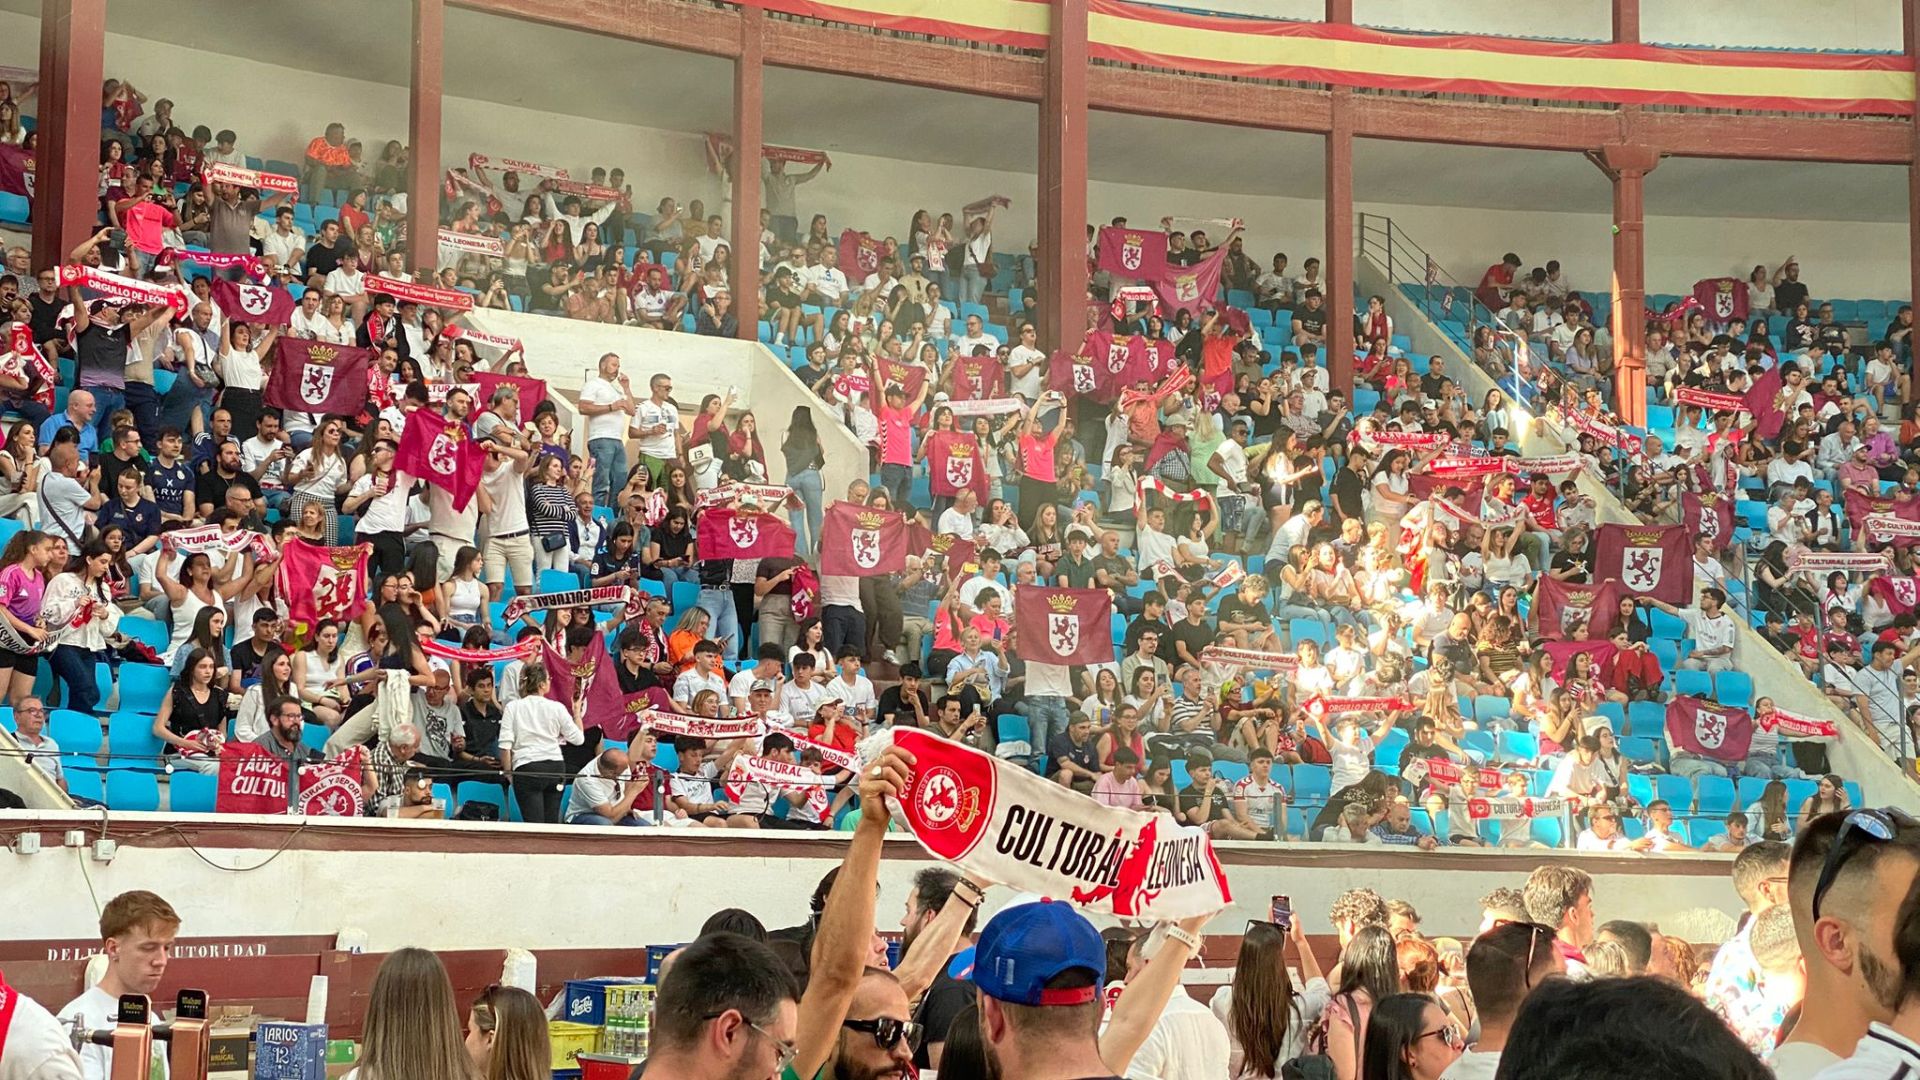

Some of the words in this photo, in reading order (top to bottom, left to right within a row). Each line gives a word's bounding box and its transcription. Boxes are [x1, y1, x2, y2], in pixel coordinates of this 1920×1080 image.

[263, 177, 297, 188] LEONES
[88, 280, 130, 297] ORGULLO
[131, 290, 144, 300] DE
[144, 291, 168, 305] LEÓN
[533, 589, 592, 607] CULTURAL
[1328, 703, 1361, 712] ORGULLO
[1362, 703, 1370, 711] DE
[748, 756, 802, 777] CULTURAL
[231, 775, 286, 799] CULTU!
[299, 783, 326, 815] ULTURAL
[995, 804, 1130, 887] CULTURAL
[1146, 835, 1205, 890] LEONESA
[48, 948, 105, 961] DELE
[264, 1026, 299, 1045] LARIOS
[272, 1046, 290, 1064] 12
